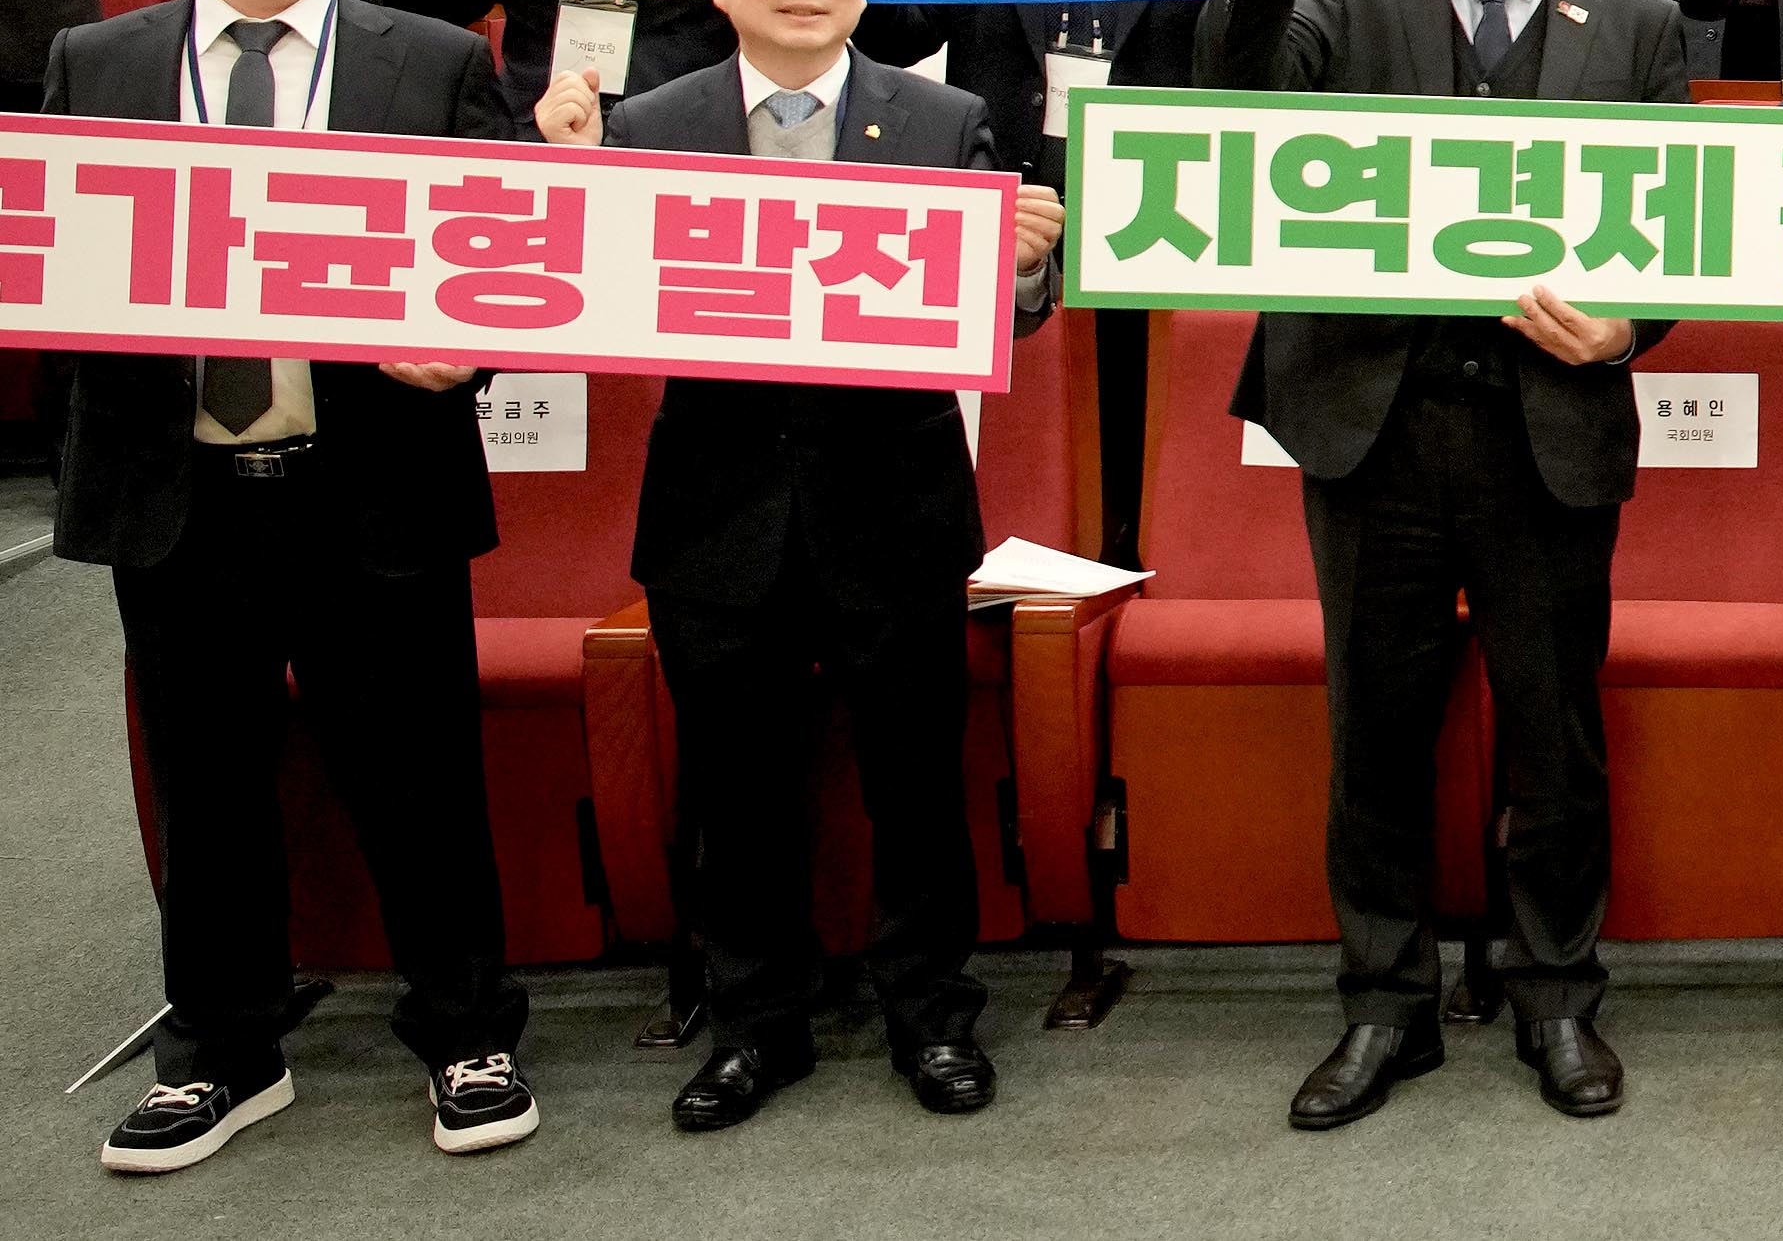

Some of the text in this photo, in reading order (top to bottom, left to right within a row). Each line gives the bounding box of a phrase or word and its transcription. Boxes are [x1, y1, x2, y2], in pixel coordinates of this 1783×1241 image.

[1106, 129, 1736, 278] 지역경제
[652, 192, 965, 349] 발전
[487, 432, 538, 445] 국회의원
[1667, 428, 1715, 443] 국회의원
